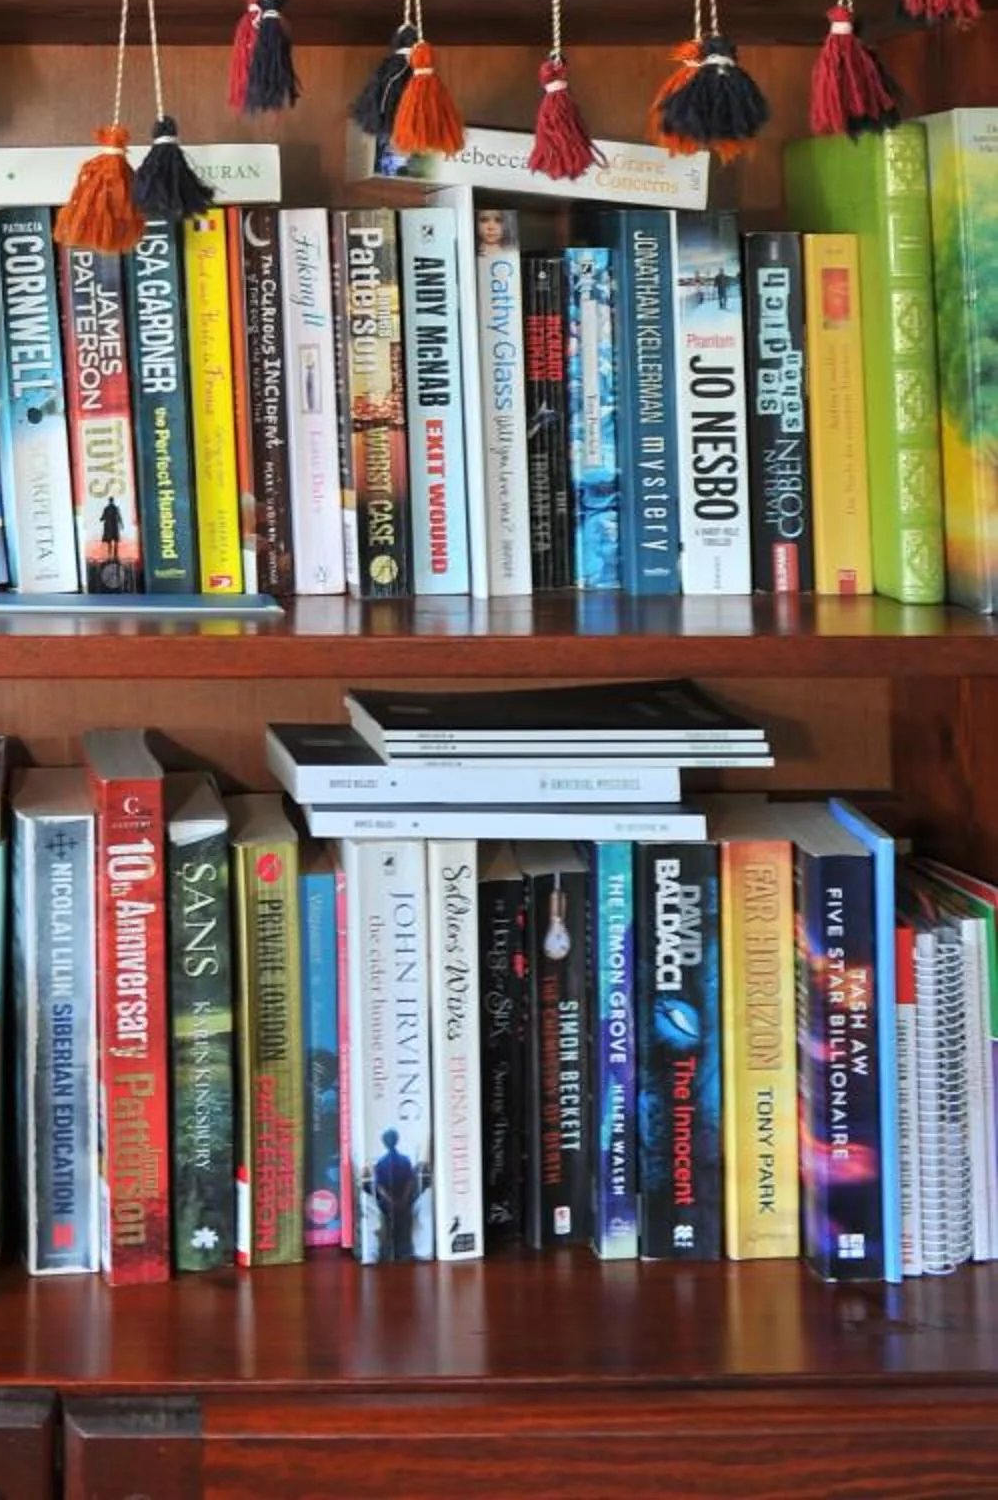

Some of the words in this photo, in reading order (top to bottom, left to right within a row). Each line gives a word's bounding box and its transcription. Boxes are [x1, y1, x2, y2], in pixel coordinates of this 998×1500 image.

[288, 225, 320, 305] Faking
[349, 227, 386, 376] Patterson
[413, 257, 449, 313] ANDY
[487, 260, 515, 336] Cathy
[634, 230, 663, 320] JONATHAN
[3, 235, 55, 399] CORNWELL
[72, 251, 102, 410] PATTERSON
[96, 284, 122, 376] JAMES
[138, 280, 177, 393] GARDNER
[259, 279, 279, 355] CURIOUS
[760, 271, 787, 352] dich
[263, 358, 285, 450] INCIDENT
[414, 325, 450, 407] McNAB
[493, 341, 516, 411] Glass
[636, 325, 665, 423] KELLERMAN
[689, 355, 735, 399] JO
[759, 373, 779, 411] Sie
[782, 354, 801, 430] sehen
[155, 407, 168, 427] the
[425, 419, 446, 478] EXIT
[84, 421, 126, 499] TOYS
[155, 429, 173, 485] Perfect
[362, 428, 388, 493] WORST
[639, 436, 670, 552] mystery
[691, 411, 739, 521] NESBO
[779, 438, 803, 538] COBEN
[158, 488, 178, 559] Husband
[366, 499, 394, 546] CASE
[428, 483, 448, 575] WOUND
[51, 863, 74, 946] NICOLAI
[175, 862, 217, 978] ŞANS
[608, 873, 625, 910] THE
[654, 858, 682, 991] BALDACCI
[678, 884, 701, 965] DAVID
[743, 863, 781, 925] FAR
[825, 887, 843, 937] FIVE
[257, 901, 285, 974] PRIVATE
[368, 914, 385, 947] the
[389, 891, 417, 983] JOHN
[608, 914, 626, 984] LEMON
[51, 949, 73, 997] LILIN
[105, 900, 157, 1058] Anniversary
[369, 952, 385, 994] cider
[445, 960, 473, 1042] Wives
[743, 934, 784, 1071] HORIZON
[826, 947, 846, 1004] STAR
[849, 969, 867, 1031] TASH
[51, 1003, 74, 1097] SIBERIAN
[192, 1000, 211, 1065] KAREN
[258, 982, 288, 1062] LONDON
[369, 998, 386, 1046] house
[394, 998, 423, 1122] IRVING
[558, 1000, 580, 1062] SIMON
[609, 991, 627, 1065] GROVE
[851, 1039, 867, 1076] AW
[371, 1050, 388, 1101] rules
[559, 1071, 581, 1151] BECKETT
[611, 1084, 626, 1134] HELEN
[674, 1057, 697, 1099] The
[827, 1014, 849, 1160] BILLIONAIRE
[191, 1068, 211, 1171] KINGSBURY
[755, 1087, 773, 1144] TONY
[52, 1103, 75, 1215] EDUCATION
[113, 1071, 155, 1246] Patterson
[256, 1074, 278, 1250] PATTERSON
[611, 1141, 626, 1196] WALSH
[672, 1104, 696, 1205] Innocent
[757, 1154, 776, 1214] PARK
